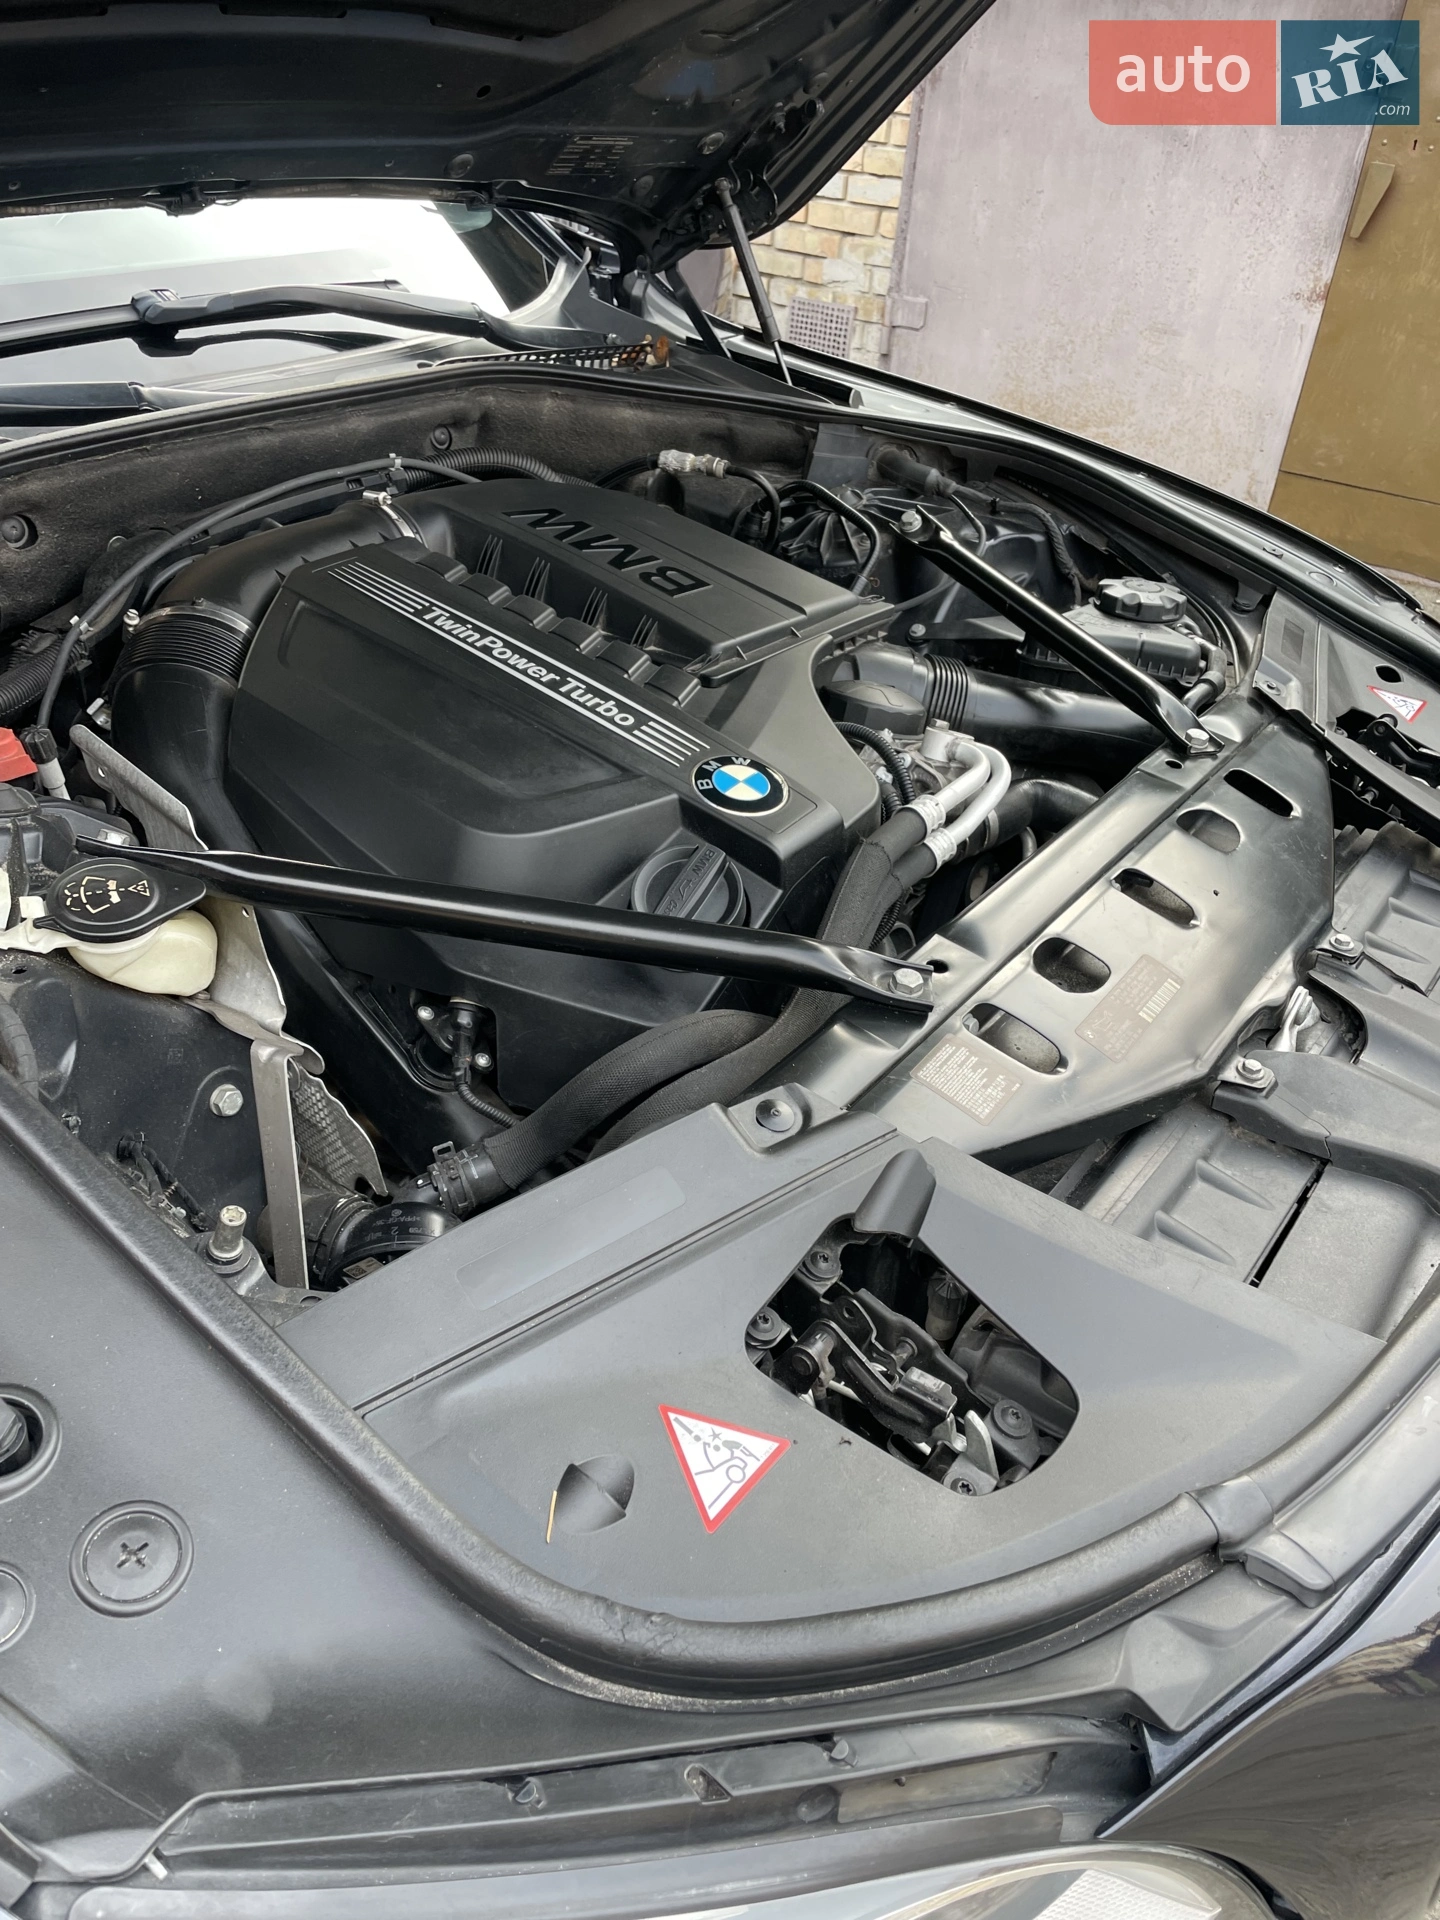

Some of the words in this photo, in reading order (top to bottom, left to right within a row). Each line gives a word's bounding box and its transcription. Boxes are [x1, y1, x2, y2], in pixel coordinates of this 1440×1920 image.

[501, 508, 713, 599] BMW
[422, 606, 560, 683] TwinPower
[558, 677, 635, 726] Turbo
[697, 757, 751, 790] BMW
[692, 848, 717, 876] BMW
